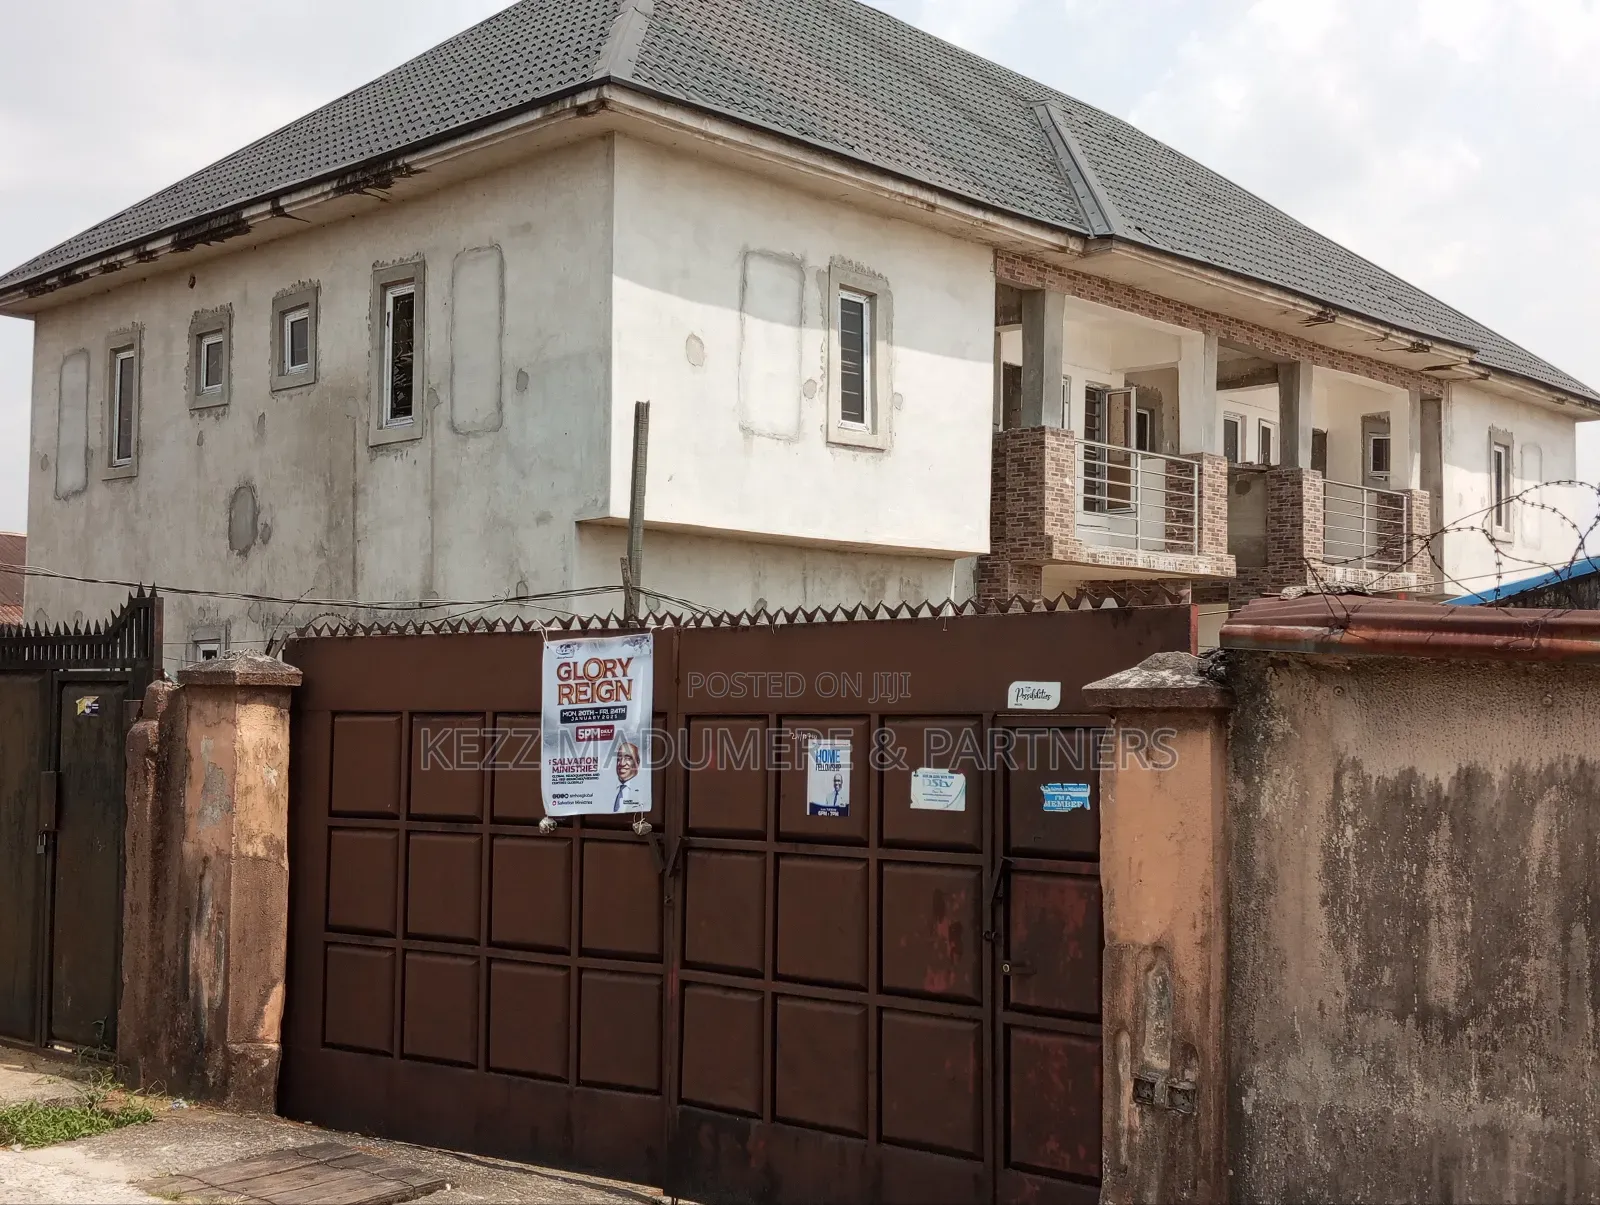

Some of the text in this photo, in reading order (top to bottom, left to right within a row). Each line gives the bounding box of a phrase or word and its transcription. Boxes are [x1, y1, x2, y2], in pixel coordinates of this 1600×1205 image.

[556, 657, 634, 682] GLORY
[557, 679, 633, 706] REIGN
[571, 714, 601, 722] JANUARY
[578, 728, 601, 740] 5PM
[816, 749, 841, 763] HOME
[552, 757, 599, 766] SALVATION
[552, 765, 598, 774] MINISTRIES
[816, 763, 842, 771] FELLOWSHIP
